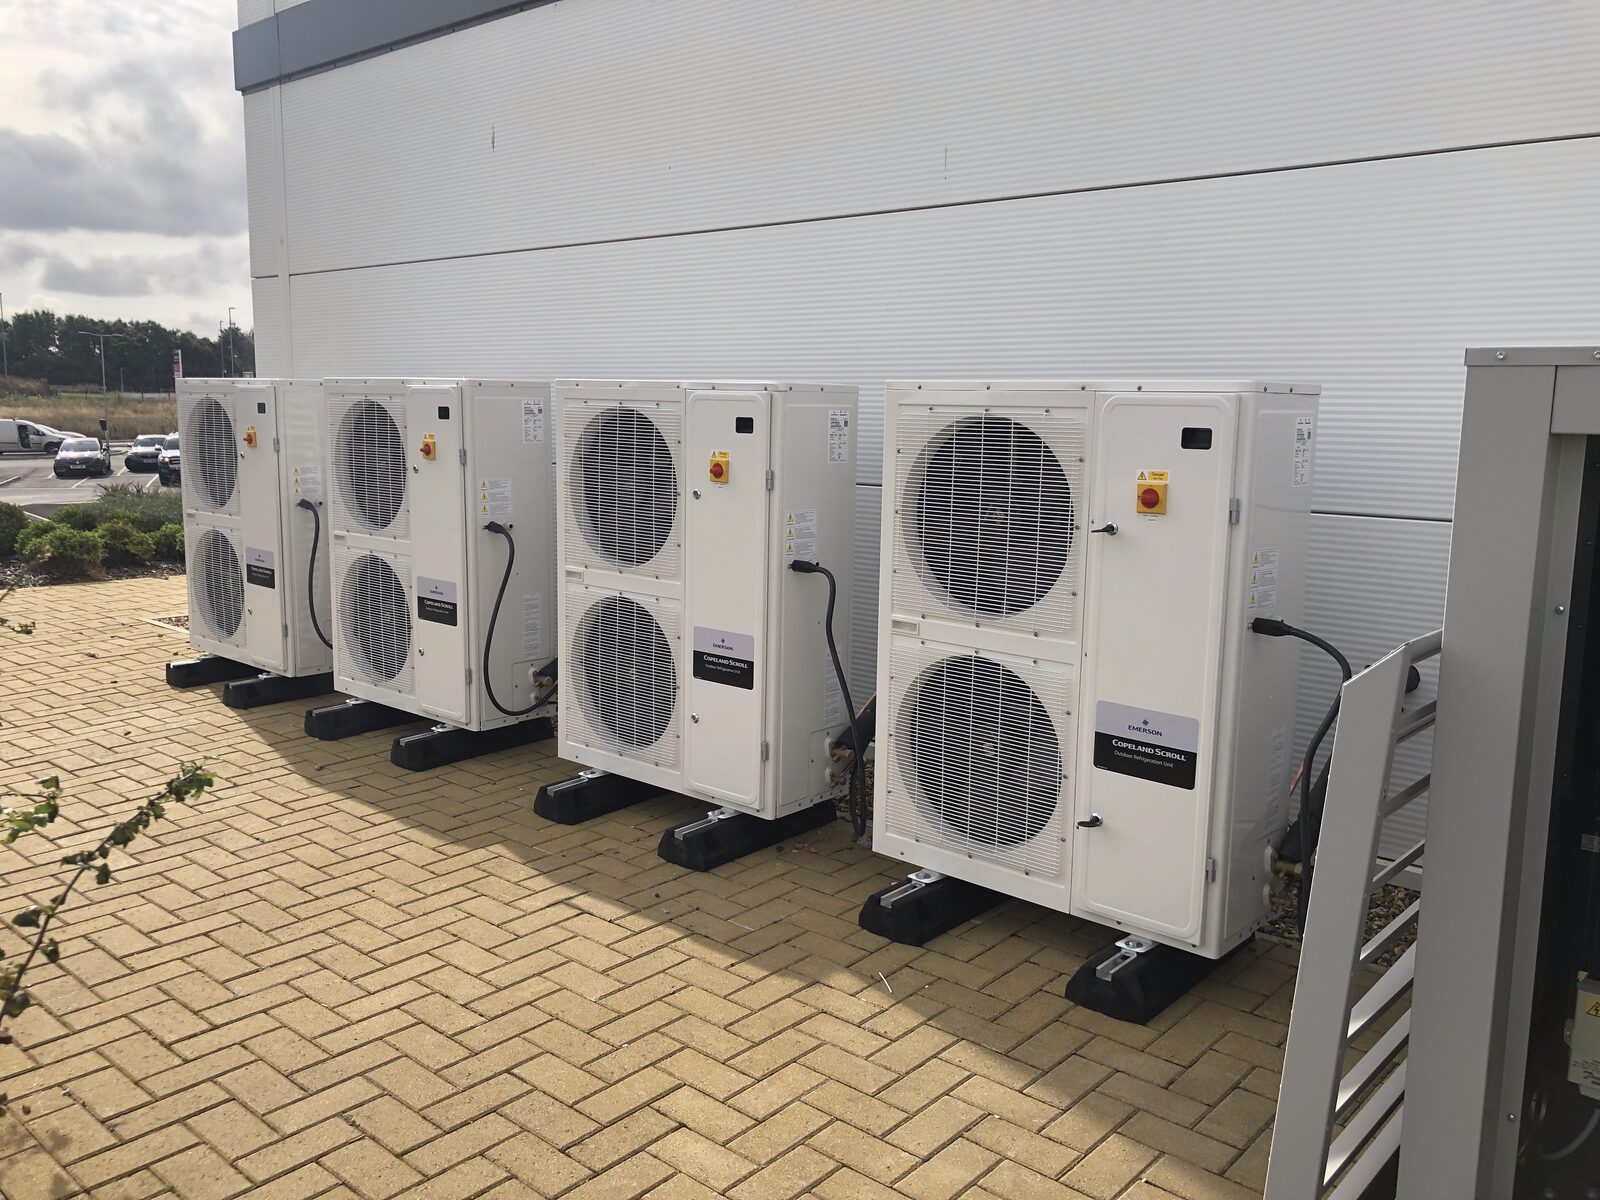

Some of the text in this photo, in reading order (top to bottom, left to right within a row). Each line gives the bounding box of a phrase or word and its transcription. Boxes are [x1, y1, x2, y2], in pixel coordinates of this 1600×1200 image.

[704, 655, 748, 668] COPELAND SCROLL
[1128, 724, 1163, 737] EMERSON
[1112, 739, 1187, 761] COPELAND SCROLL
[1113, 750, 1174, 768] Outdoor Refrigeration Unit
